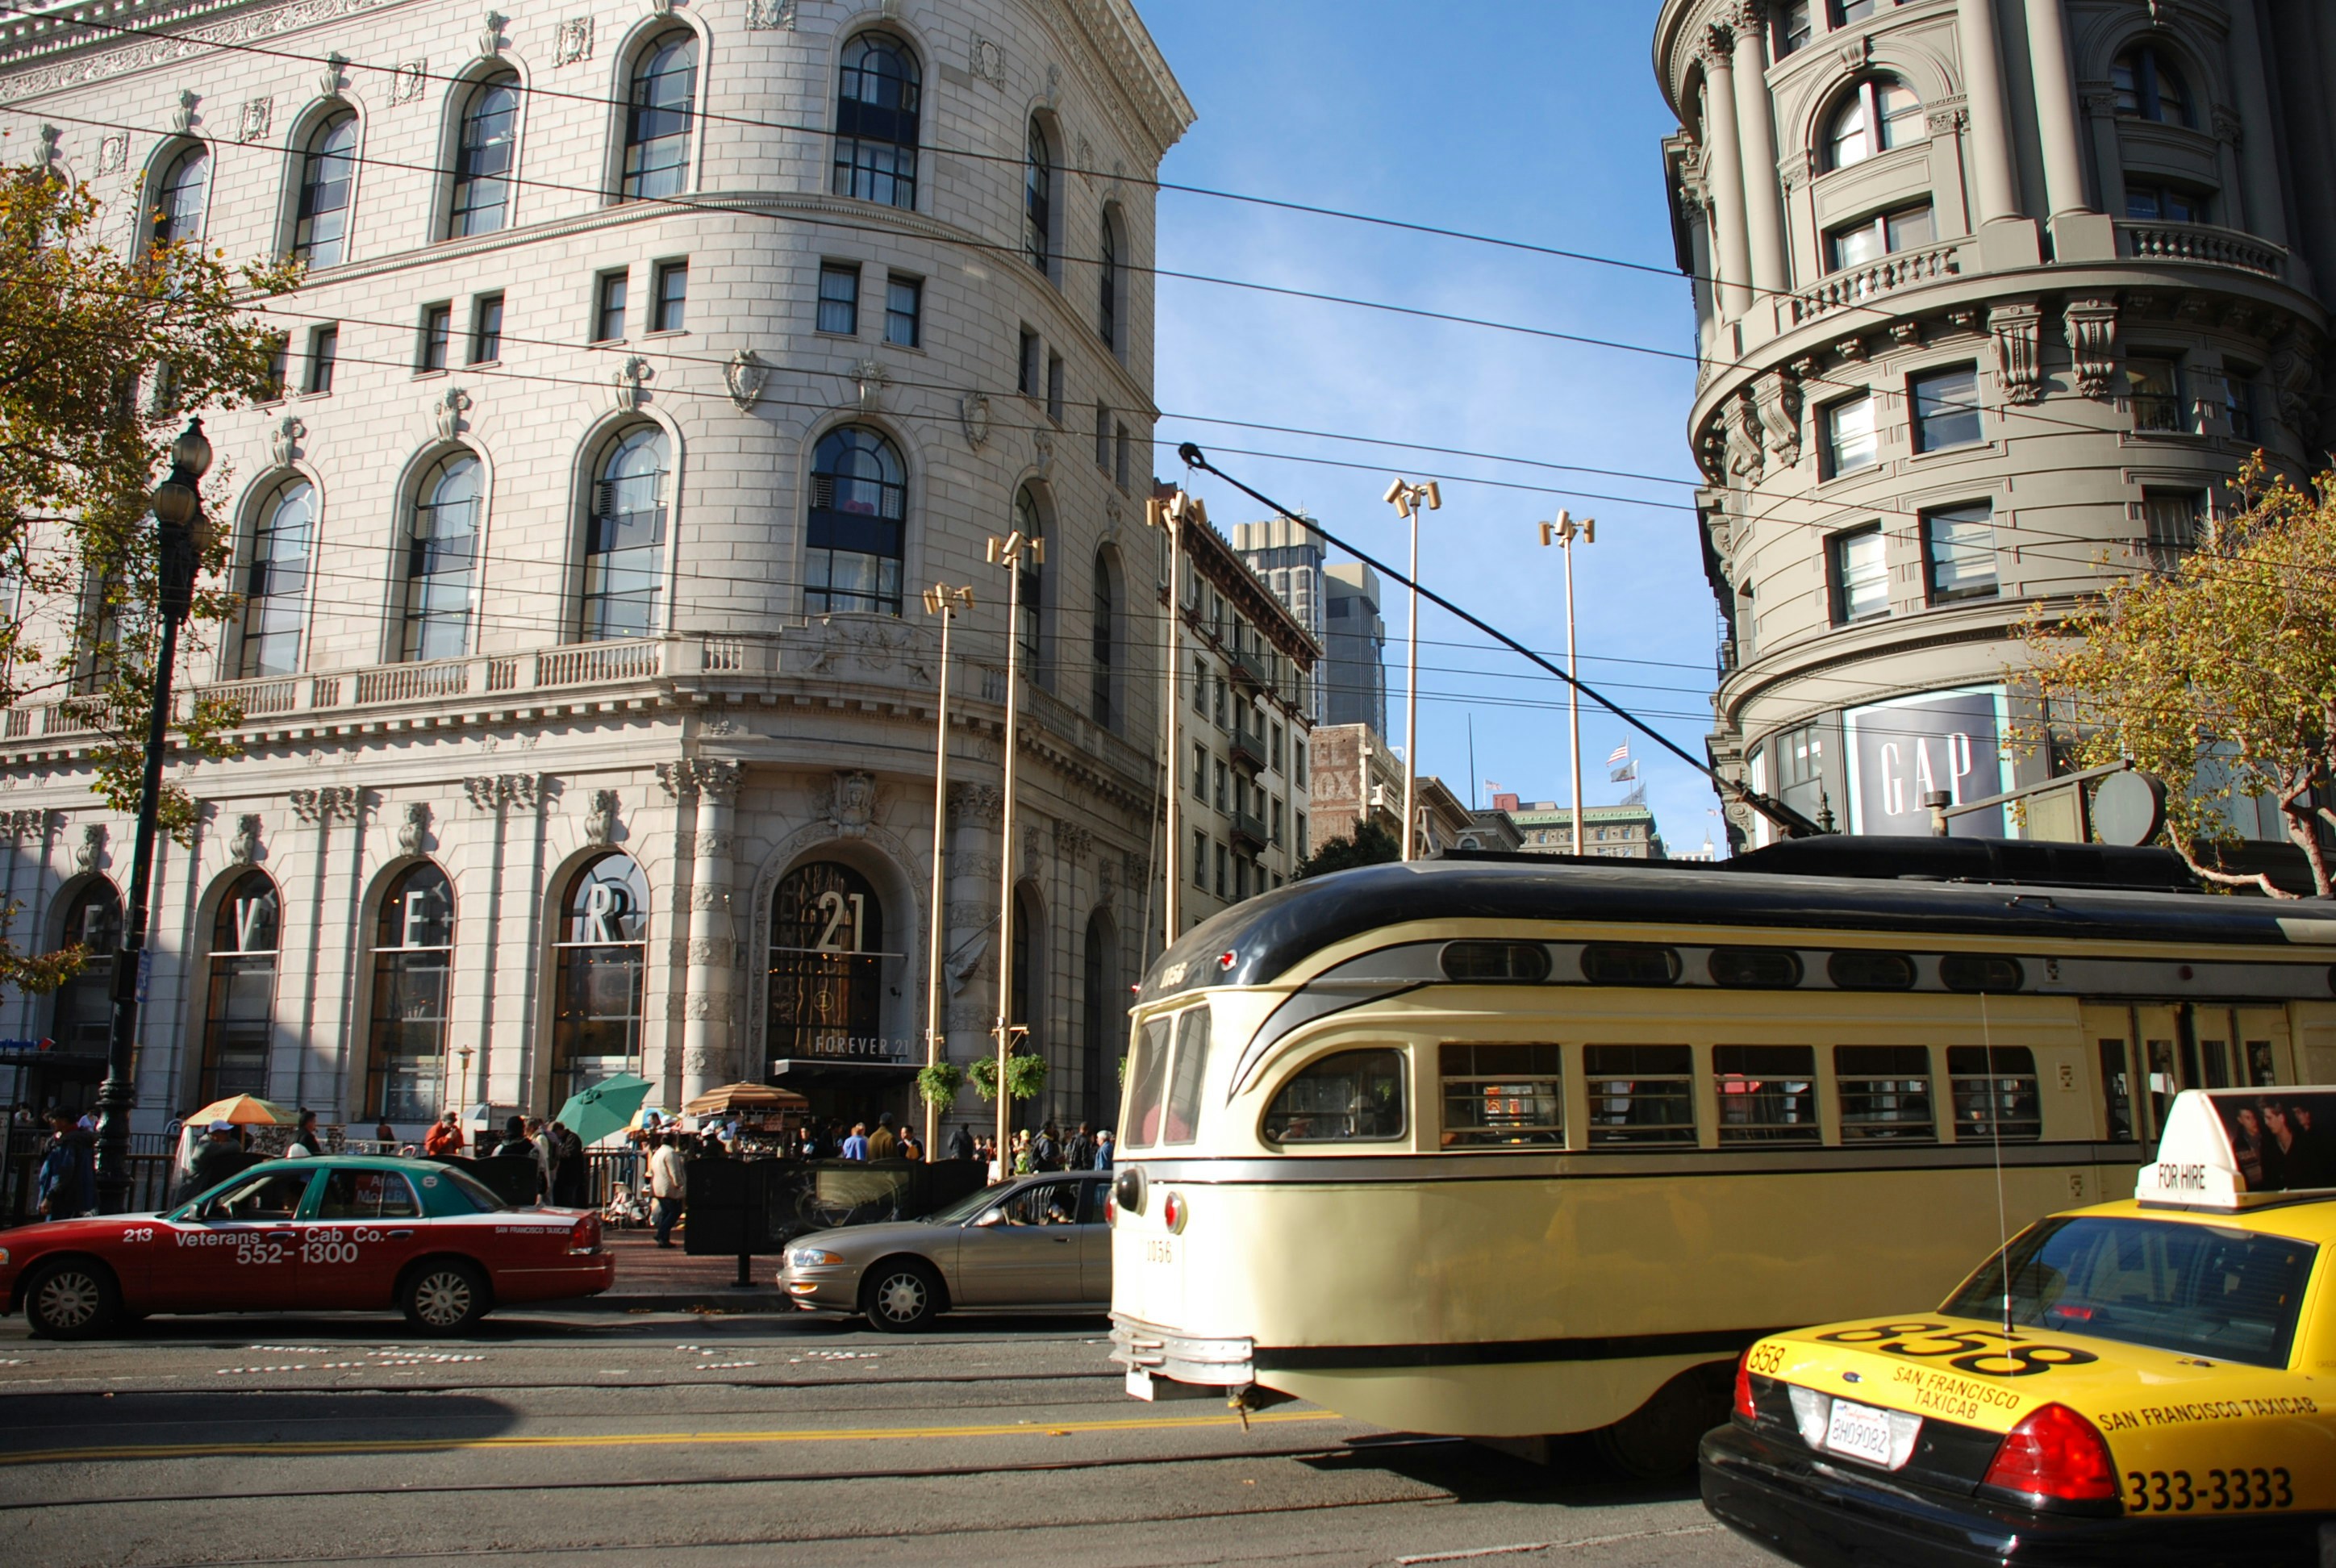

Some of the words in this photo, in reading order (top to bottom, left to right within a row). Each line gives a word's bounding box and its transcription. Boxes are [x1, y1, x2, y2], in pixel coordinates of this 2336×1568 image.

[1310, 769, 1357, 801] OX
[1881, 732, 1971, 815] GAP
[235, 897, 260, 953] V
[403, 890, 424, 948] E
[589, 883, 611, 942] R
[816, 890, 865, 953] 21
[816, 1036, 888, 1055] FOREVER
[895, 1039, 908, 1056] 21
[2159, 1163, 2178, 1188] FOR
[2180, 1164, 2206, 1190] HIRE
[123, 1228, 153, 1242] 213
[175, 1231, 261, 1247] Veterans
[305, 1227, 344, 1243] Cab
[352, 1227, 386, 1242] Co.
[495, 1226, 507, 1234] SAN
[546, 1227, 571, 1235] TAXICAB
[236, 1242, 359, 1264] 552-1300
[1147, 1240, 1172, 1263] 1056
[1750, 1343, 1786, 1374] 858
[1816, 1323, 2099, 1377] 858
[1893, 1366, 1924, 1386] SAN
[1925, 1373, 2020, 1410] FRANCISCO
[1914, 1388, 1979, 1420] TAXICAB
[2099, 1410, 2140, 1432] SAN
[2140, 1401, 2242, 1426] FRANCISCO
[2242, 1396, 2318, 1416] TAXICAB
[2127, 1466, 2294, 1512] 333-3333
